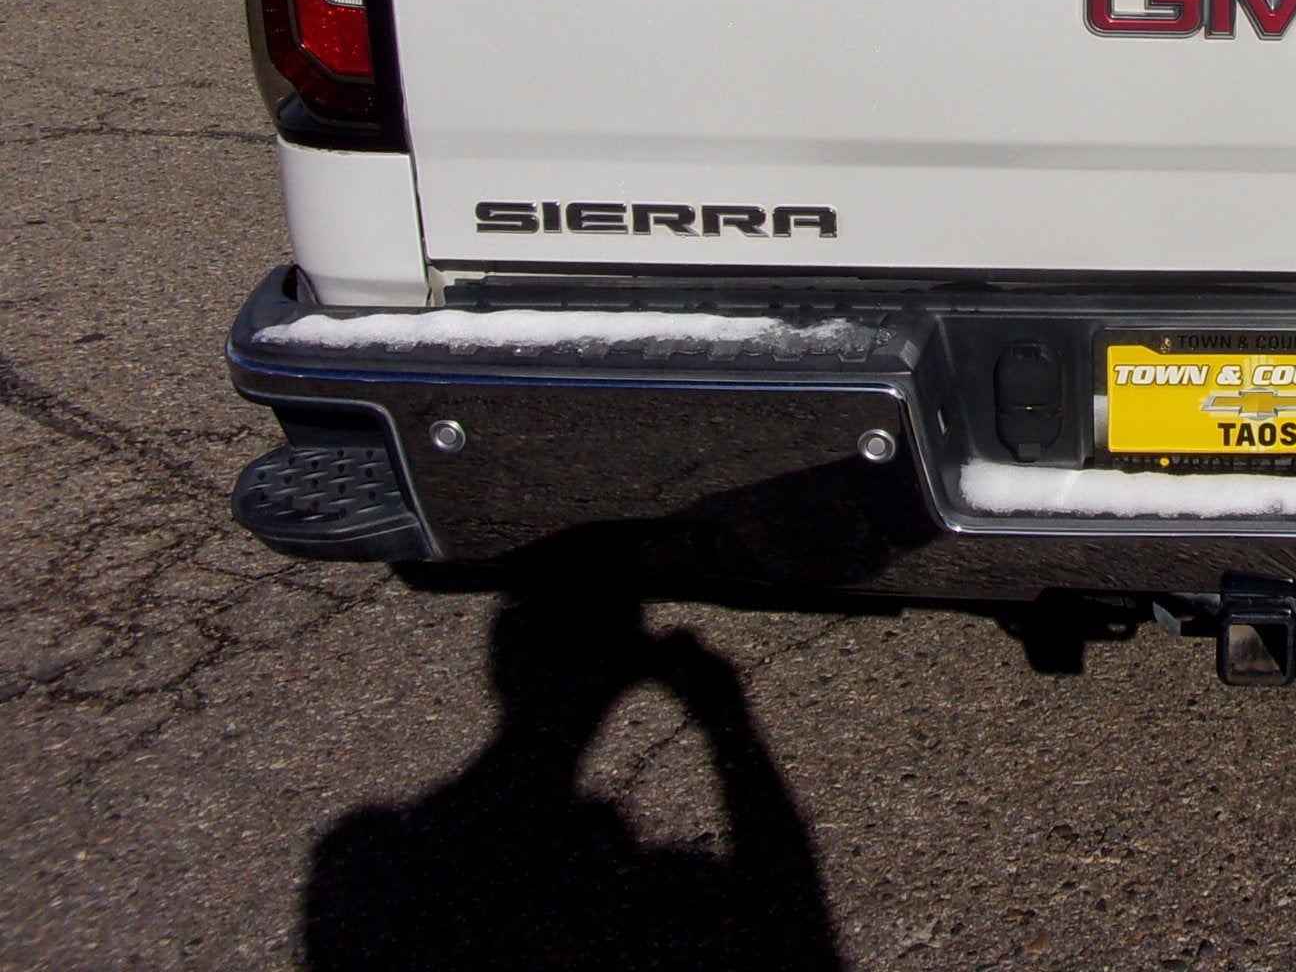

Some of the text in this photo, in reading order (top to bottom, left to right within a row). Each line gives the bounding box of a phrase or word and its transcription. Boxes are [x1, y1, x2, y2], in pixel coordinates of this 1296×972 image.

[475, 201, 838, 238] SIERRA
[1177, 334, 1234, 350] TOWN
[1238, 334, 1250, 350] &
[1113, 363, 1209, 386] TOWN
[1216, 363, 1243, 386] &
